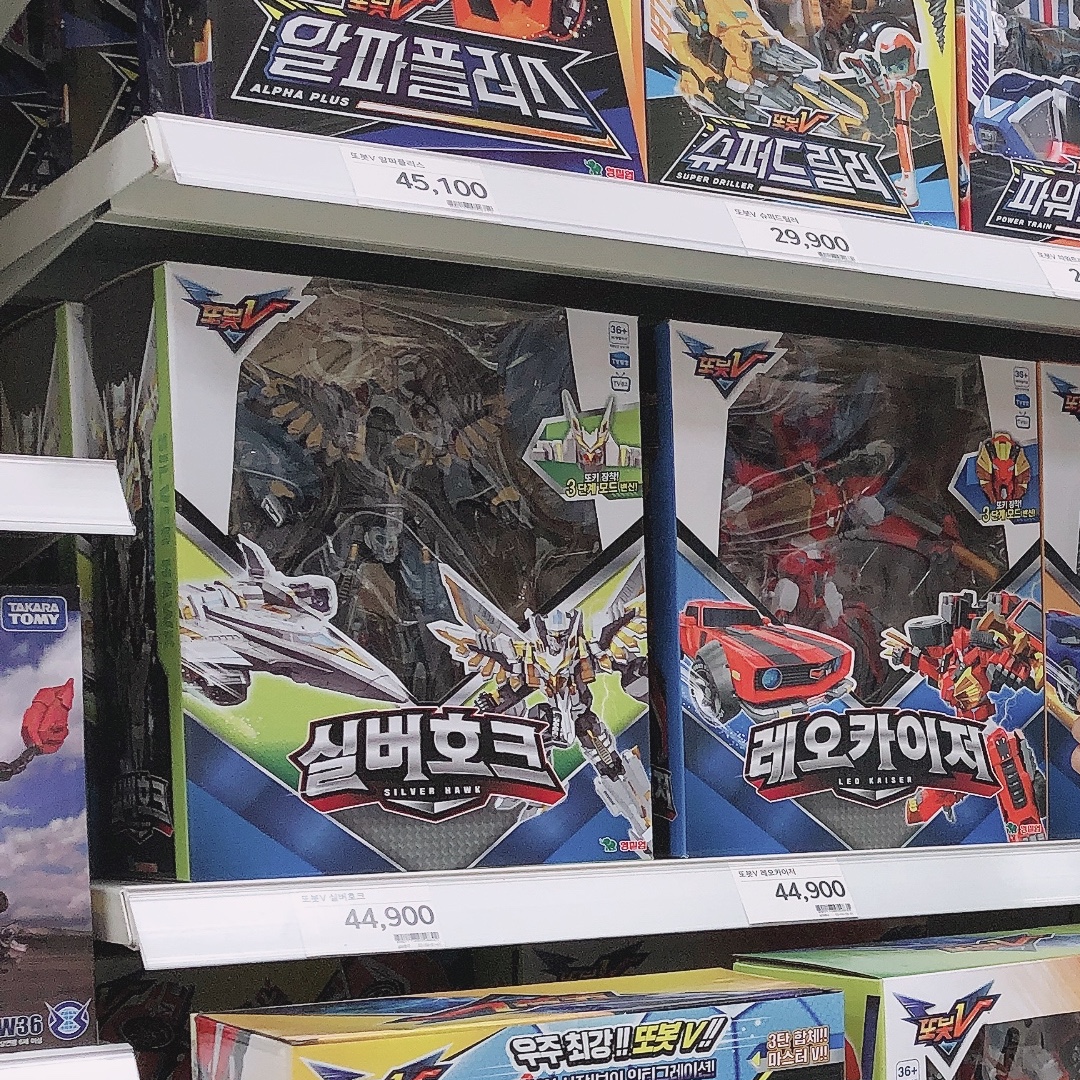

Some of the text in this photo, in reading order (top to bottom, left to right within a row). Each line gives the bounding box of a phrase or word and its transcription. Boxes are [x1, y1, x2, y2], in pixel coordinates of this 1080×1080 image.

[271, 14, 592, 128] 알파플러스
[249, 82, 351, 108] ALPHA PLUS
[688, 126, 893, 201] 슈퍼드릴러
[394, 171, 489, 200] 45,100
[675, 171, 755, 192] SUPER DRILLER
[995, 214, 1052, 231] POWER TRAIN
[769, 225, 850, 253] 29,900
[610, 325, 628, 336] 36+
[584, 472, 599, 483] 또키
[565, 478, 577, 498] 3
[598, 480, 619, 495] 모드
[8, 600, 61, 614] TAKARA
[7, 611, 61, 626] TOMY
[299, 709, 549, 795] 실버호크
[745, 712, 992, 785] 레오카이저
[839, 775, 913, 786] LEO KAISER
[384, 784, 483, 798] SILVER HAWK
[773, 878, 848, 903] 44,900
[344, 904, 435, 932] 44,900
[767, 1032, 792, 1050] 3단
[511, 1034, 564, 1071] 우주
[767, 1050, 810, 1068] 마스터
[898, 1065, 919, 1078] 36+
